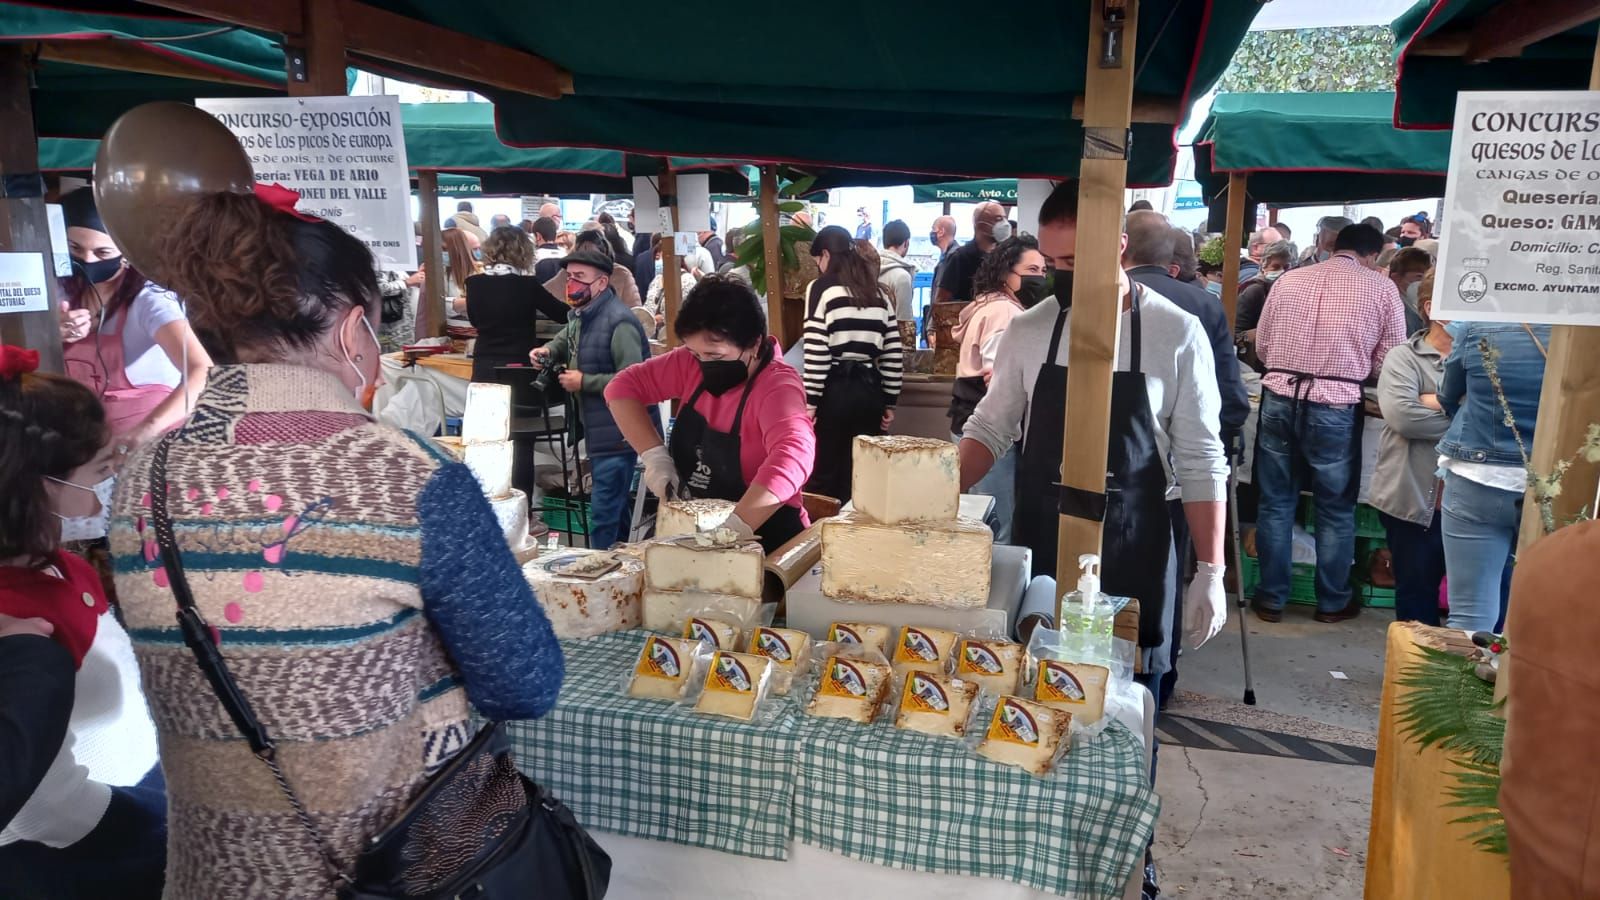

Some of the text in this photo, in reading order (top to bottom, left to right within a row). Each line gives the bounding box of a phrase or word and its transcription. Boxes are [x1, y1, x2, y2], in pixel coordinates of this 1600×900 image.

[211, 106, 391, 131] ONCURSO-EXPOSICIÓN
[237, 135, 255, 149] OS
[345, 154, 396, 163] OCTUBRE
[294, 169, 326, 181] VEGA
[329, 169, 346, 181] DE
[350, 169, 379, 181] ARIO
[1476, 169, 1549, 181] CANGAS
[330, 188, 351, 200] DEL
[354, 188, 387, 199] VALLE
[936, 189, 974, 198] Excmo.
[1481, 214, 1554, 229] Queso:
[1510, 240, 1583, 254] Domicilio:
[1535, 263, 1563, 276] Reg.
[1494, 282, 1600, 294] EXCMO. AYUNTAM
